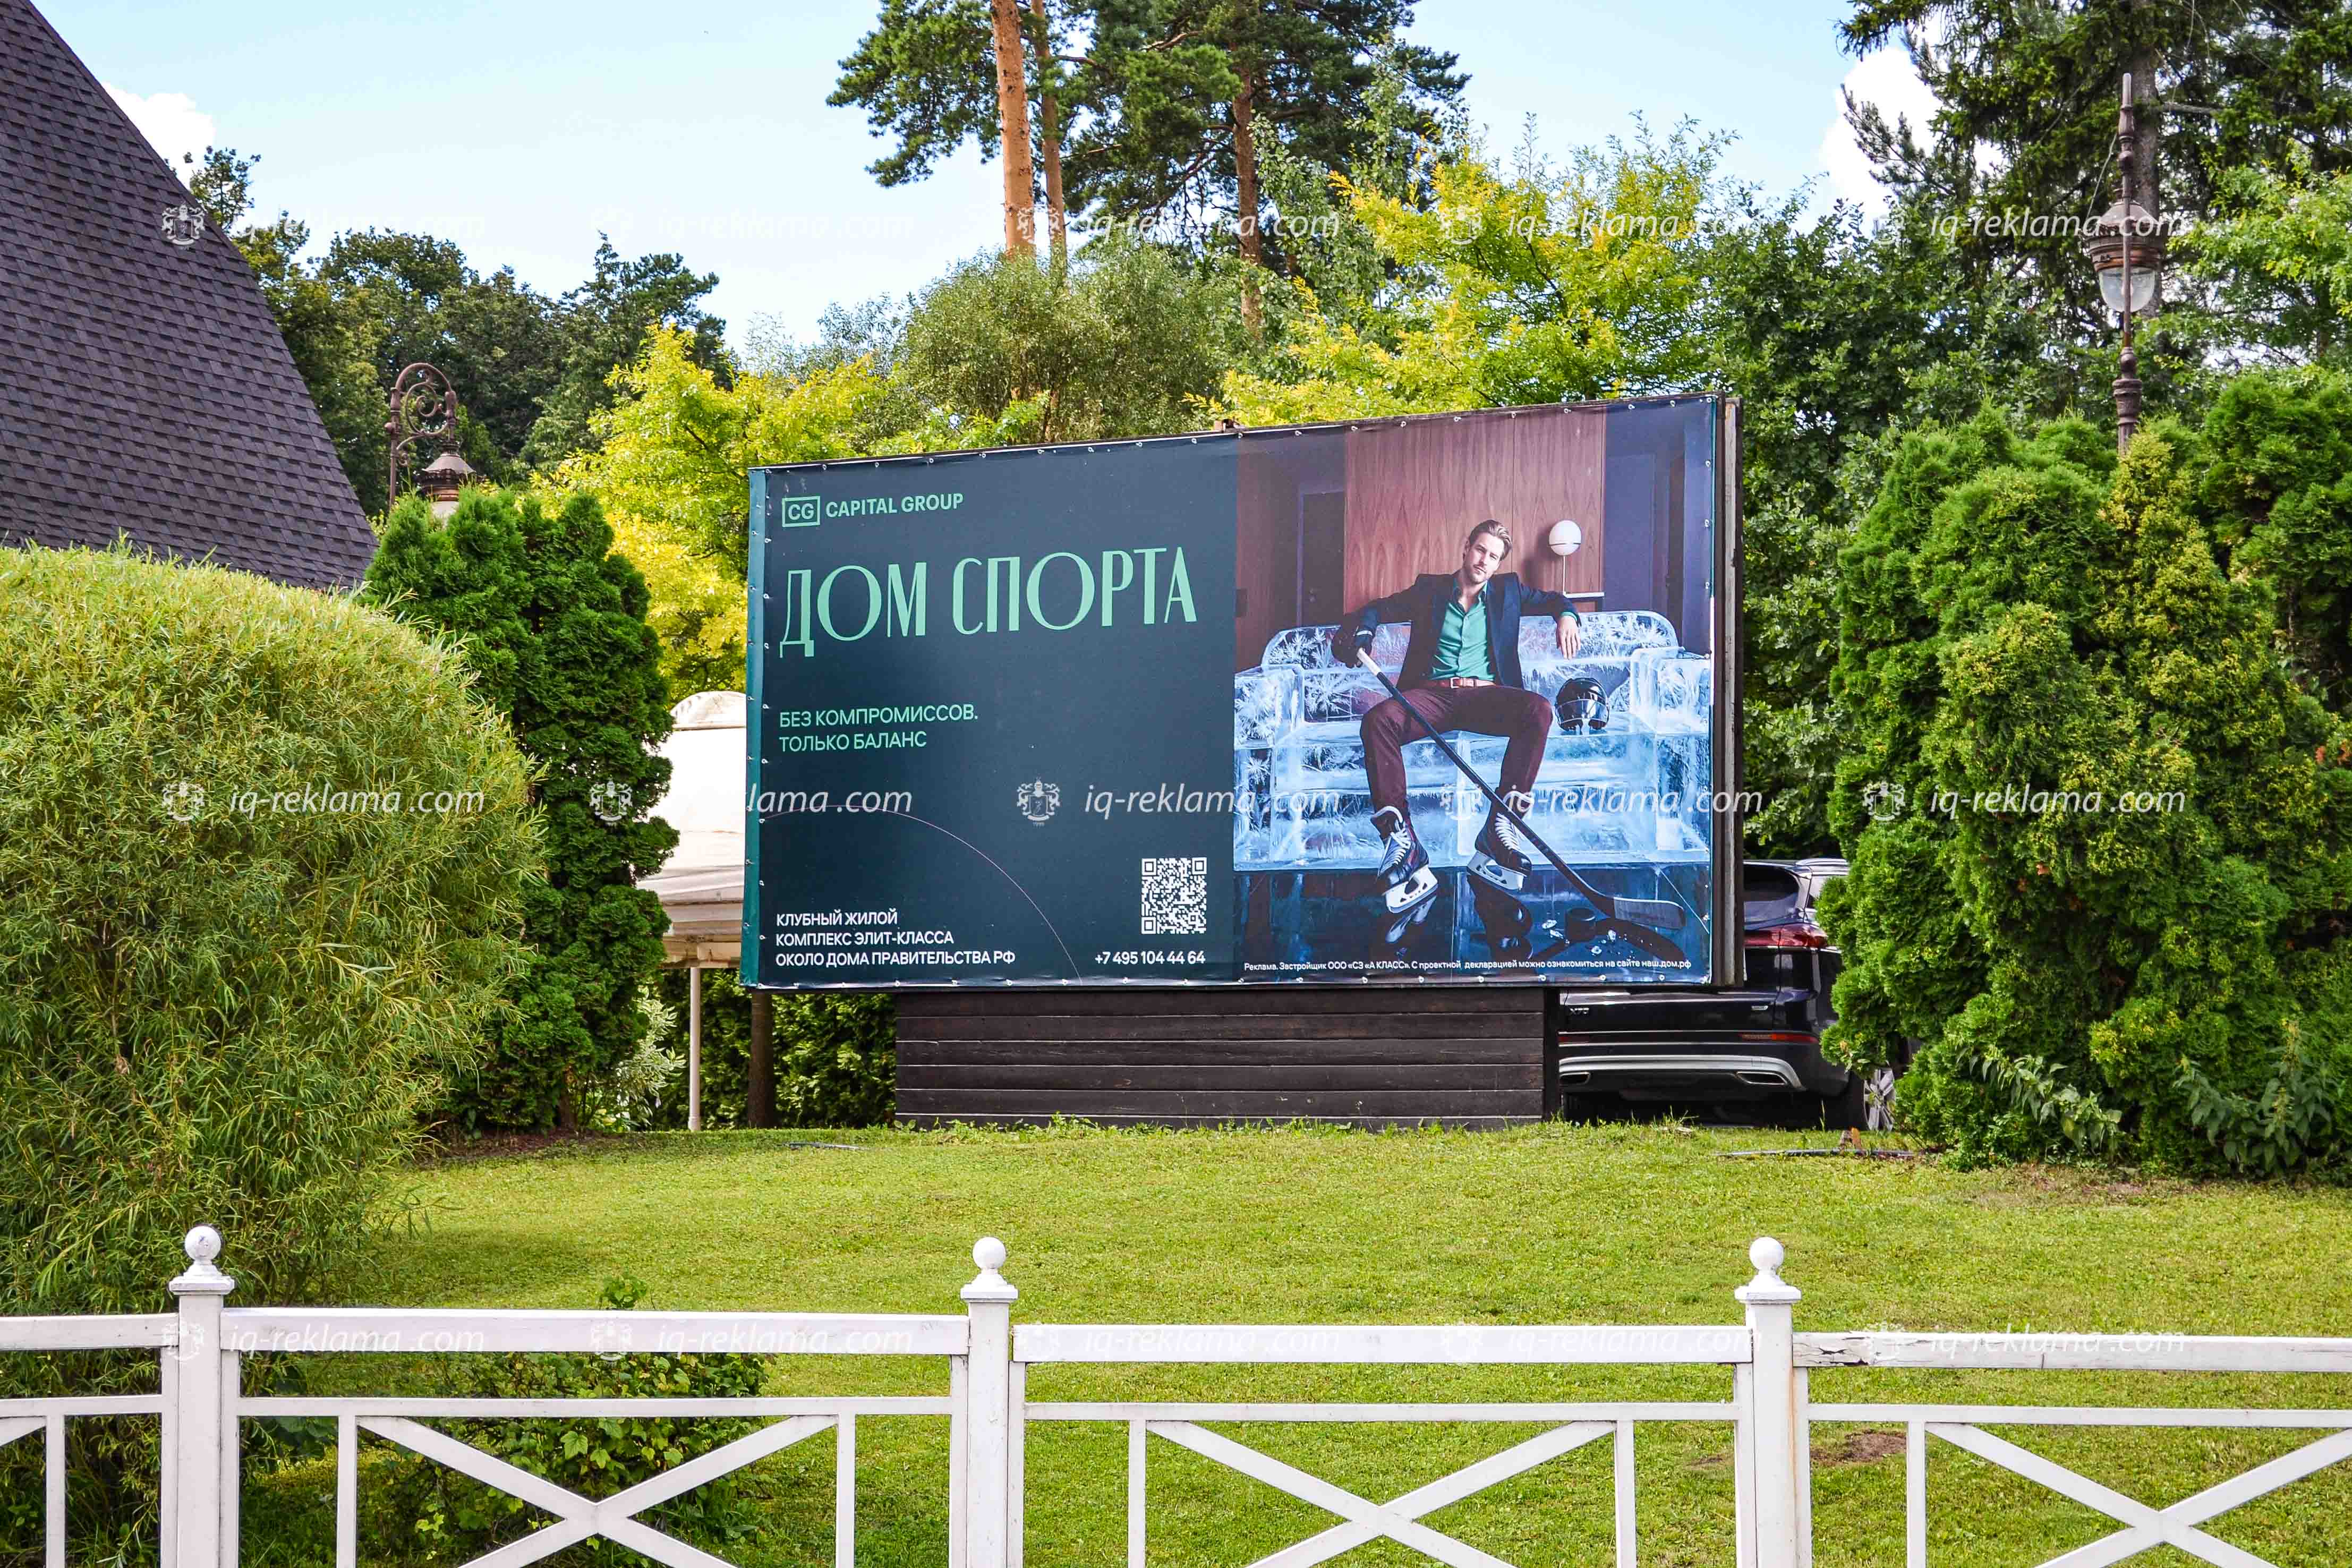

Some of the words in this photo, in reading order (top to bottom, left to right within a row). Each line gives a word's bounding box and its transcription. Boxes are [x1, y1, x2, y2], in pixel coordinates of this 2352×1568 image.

[788, 504, 814, 520] CG
[825, 498, 898, 518] CAPITAL
[902, 493, 964, 513] GROUP
[779, 562, 927, 658] ДОМ
[952, 547, 1197, 636] СПОРТА
[779, 711, 812, 728] БЕЗ
[816, 704, 978, 726] КОМПРОМИССОВ.
[779, 735, 850, 753] ТОЛЬКО
[854, 731, 927, 749] БАЛАНС
[777, 909, 842, 926] КЛУБНЫЙ
[844, 908, 898, 925] ЖИЛОЙ
[776, 933, 852, 946] КОМПЛЕКС
[854, 931, 955, 945] ЭЛИТ-КЛАССА
[776, 953, 825, 966] ОКОЛО
[826, 952, 870, 967] ДОМА
[871, 951, 992, 965] ПРАВИТЕЛЬСТВА
[993, 951, 1016, 965] РФ
[1095, 951, 1111, 965] +7
[1113, 951, 1138, 965] 495
[1140, 951, 1165, 965] 104
[1166, 951, 1185, 965] 44
[1187, 951, 1206, 965] 64
[1279, 961, 1327, 971] Застройщик
[1419, 960, 1461, 970] проектной
[1464, 959, 1518, 971] декларацией
[1616, 959, 1640, 967] сайте
[1641, 960, 1692, 969] наш.дом.рф
